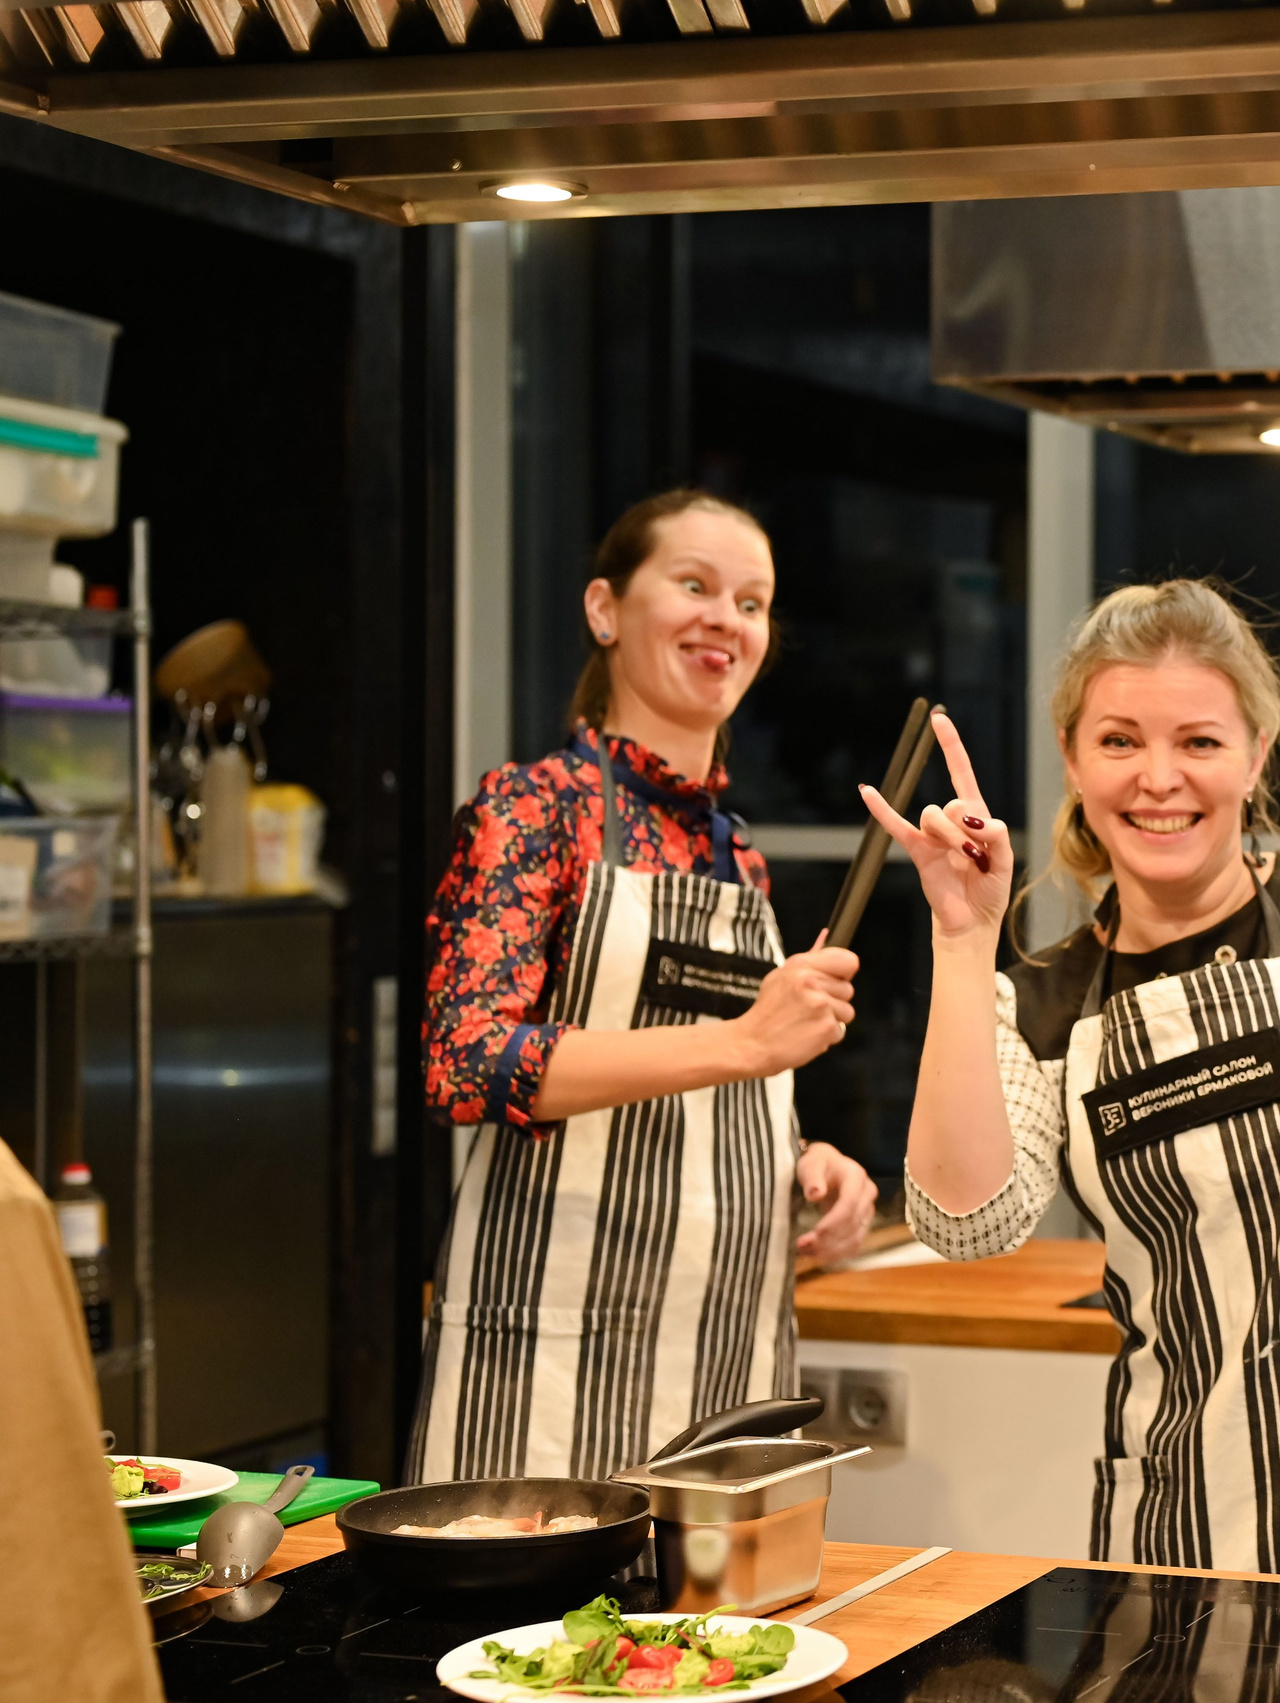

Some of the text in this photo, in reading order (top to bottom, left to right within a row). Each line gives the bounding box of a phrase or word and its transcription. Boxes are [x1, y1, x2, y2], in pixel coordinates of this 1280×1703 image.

[1127, 1055, 1257, 1108] КУЛИНАРНЫЙ САЛОН
[1131, 1062, 1274, 1121] ВЕРОНИКИ ЕРМАКОВОЙ
